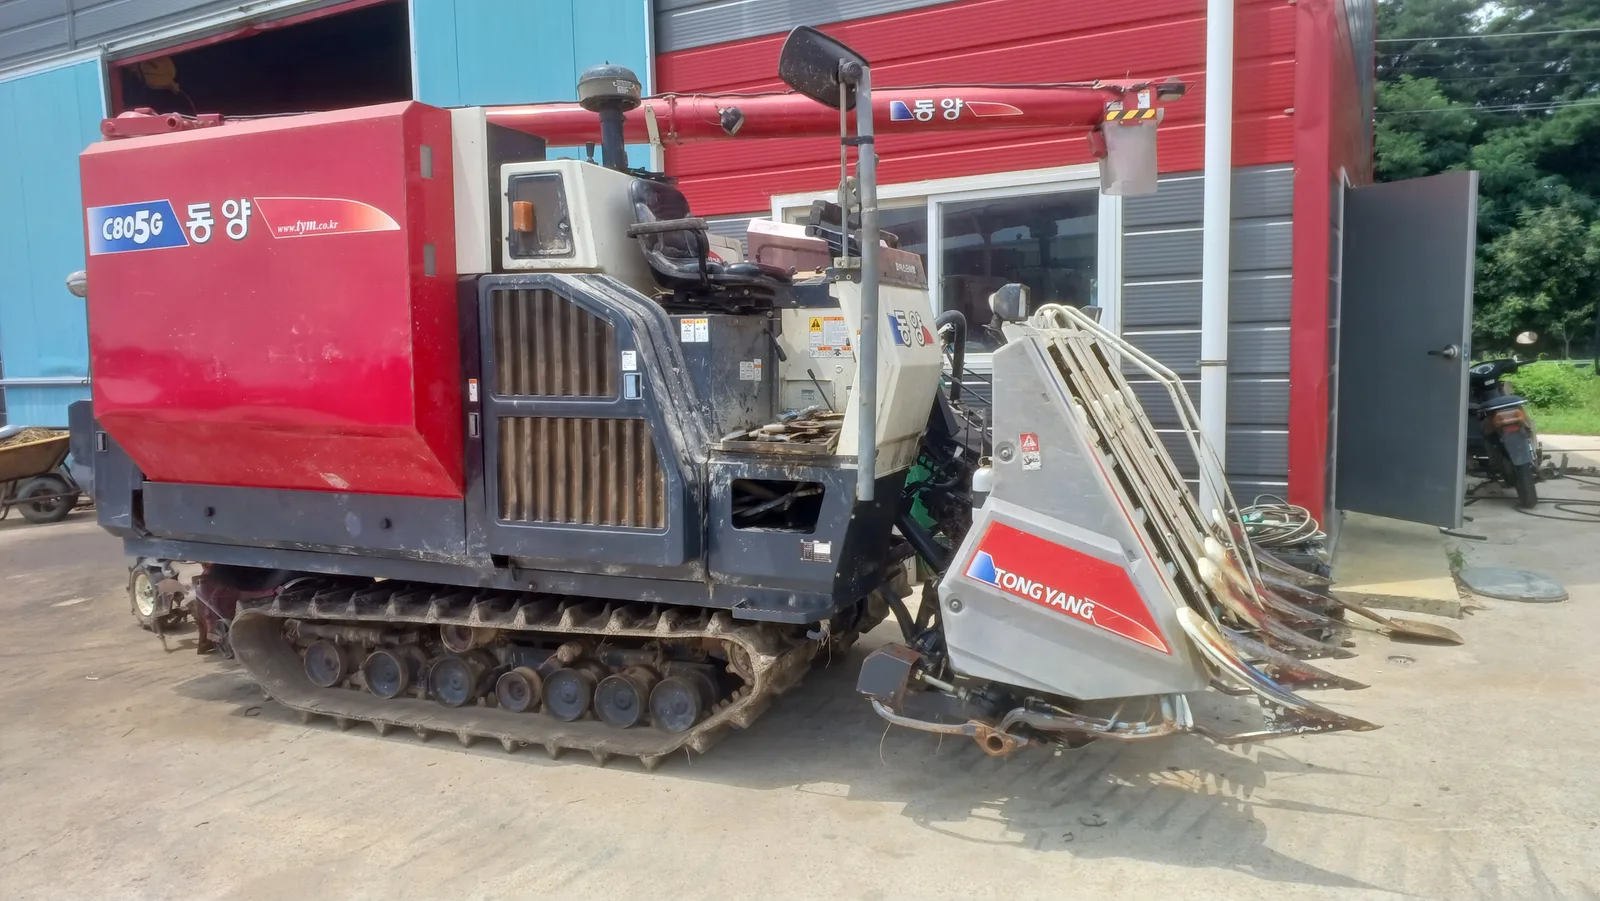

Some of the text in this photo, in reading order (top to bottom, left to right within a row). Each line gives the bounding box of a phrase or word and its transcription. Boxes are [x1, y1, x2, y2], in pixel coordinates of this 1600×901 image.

[913, 97, 963, 122] 동양
[102, 209, 163, 244] C805G
[186, 199, 252, 244] 동양
[277, 219, 339, 235] www.tym.co.kr
